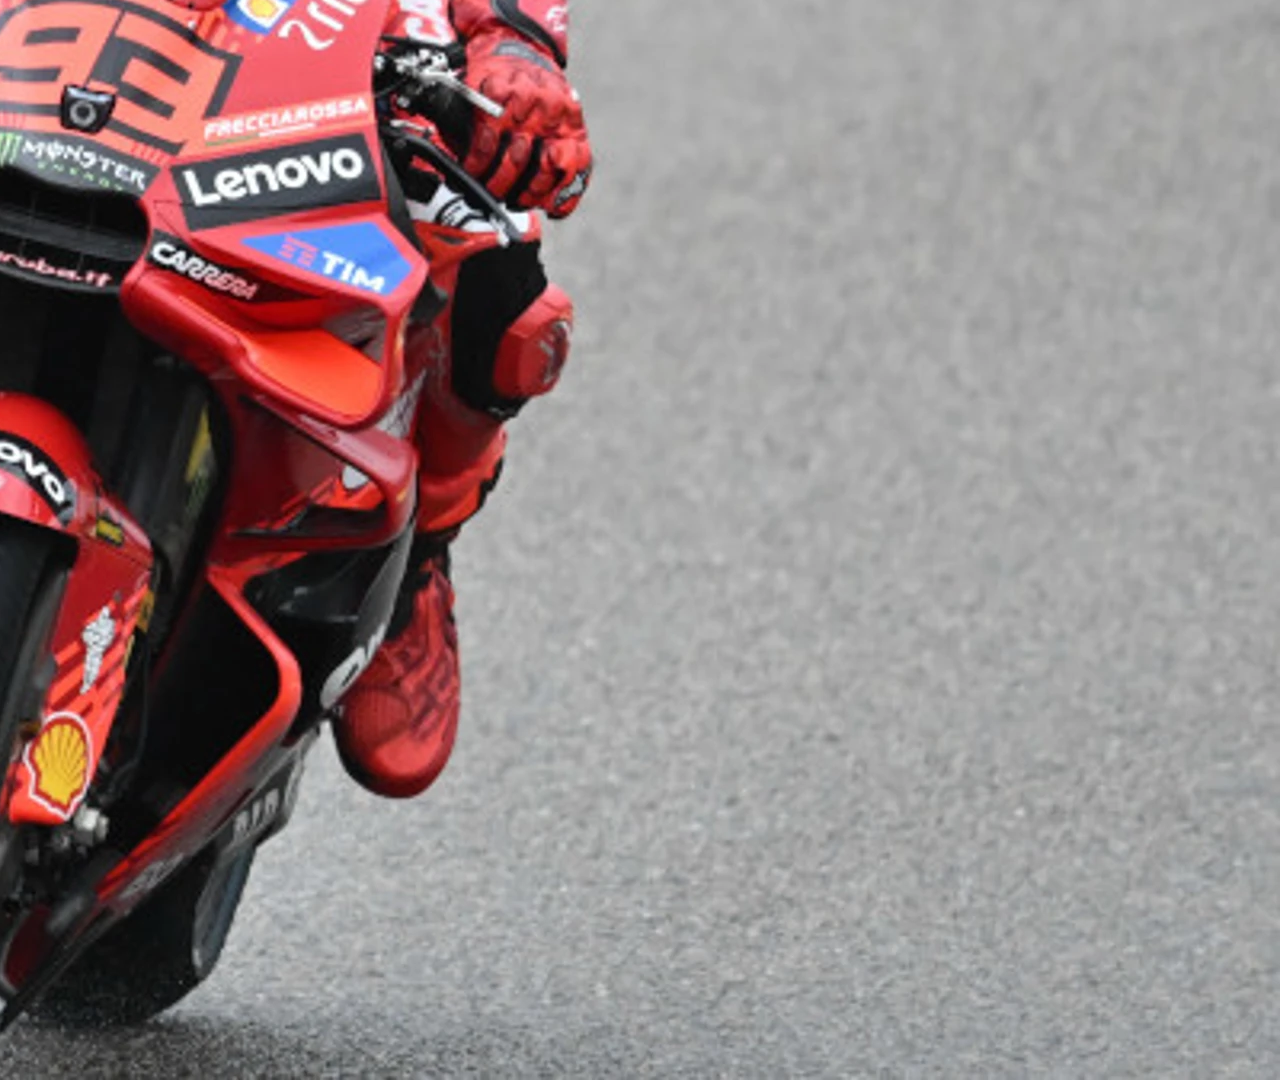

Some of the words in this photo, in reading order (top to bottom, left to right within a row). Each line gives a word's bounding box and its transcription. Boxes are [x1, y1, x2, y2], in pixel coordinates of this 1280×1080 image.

[203, 97, 370, 140] FRECCIAROSSA
[21, 138, 147, 191] MONSTER
[182, 147, 365, 207] Lenovo
[150, 240, 261, 301] CARRERA
[322, 251, 386, 294] TIM
